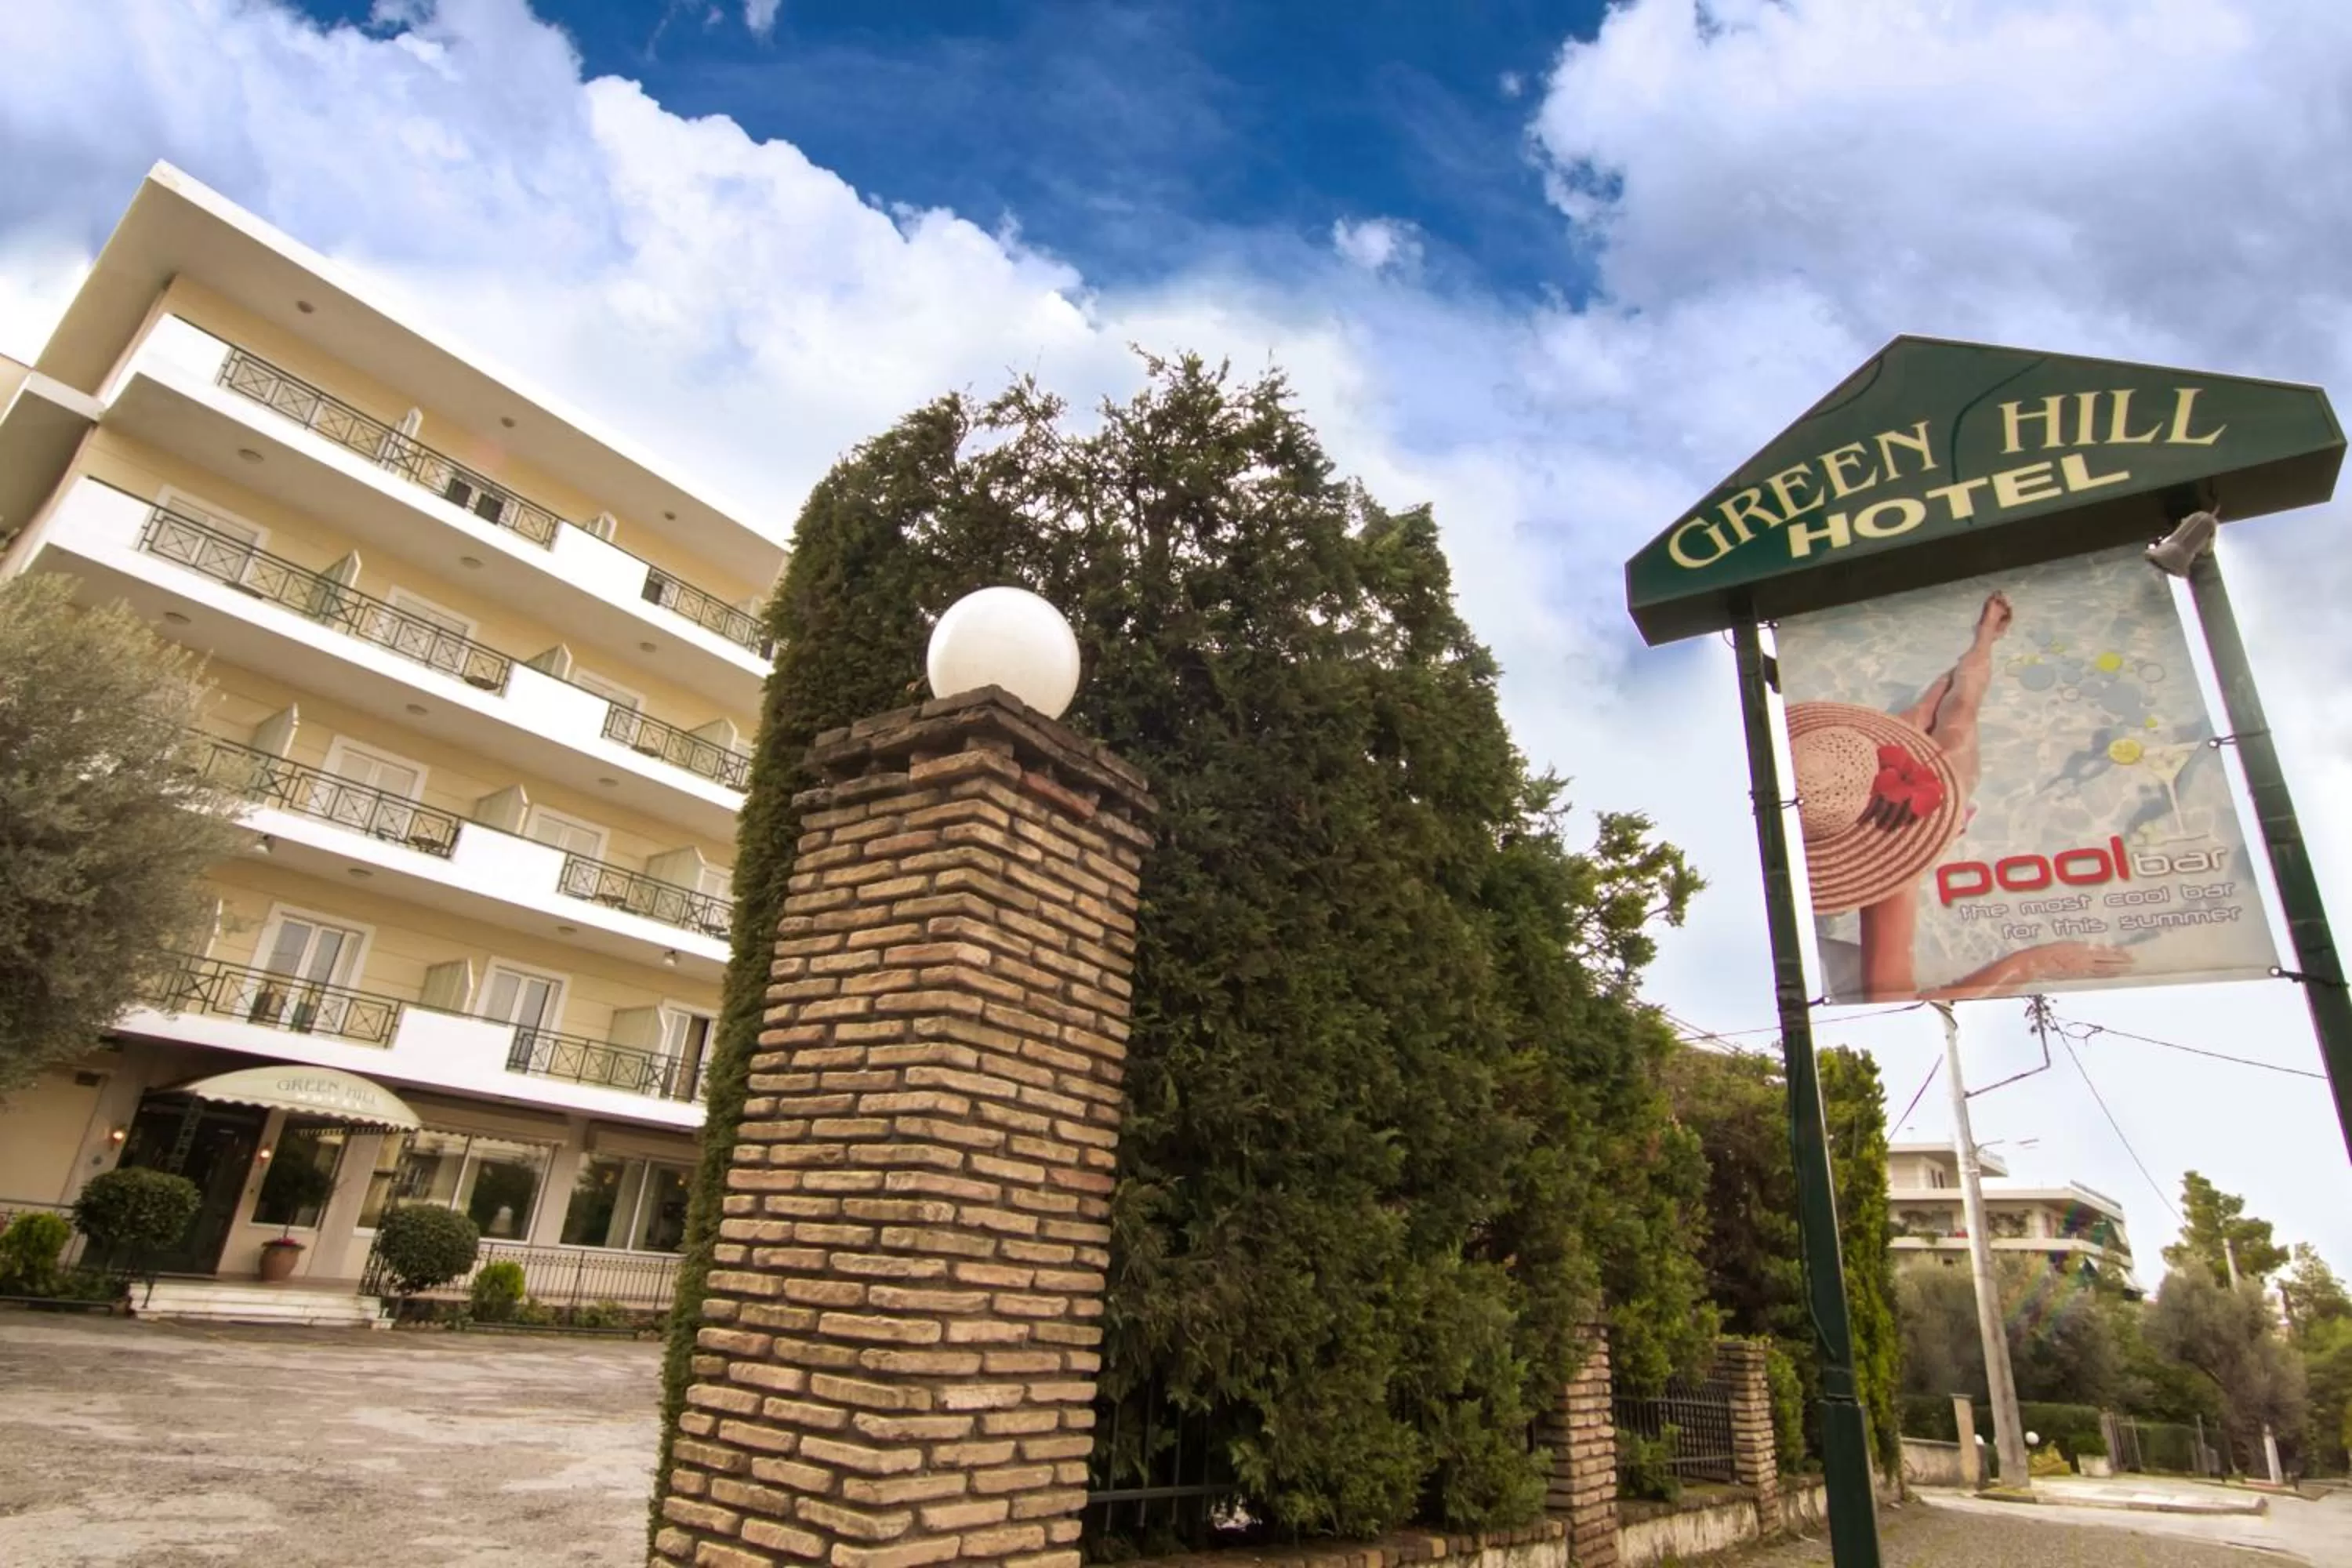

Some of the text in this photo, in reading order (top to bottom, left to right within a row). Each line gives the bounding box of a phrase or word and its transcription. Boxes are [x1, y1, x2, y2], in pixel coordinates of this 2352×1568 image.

[1668, 387, 2228, 570] GREEN HILL
[1788, 452, 2133, 559] HOTEL
[1959, 880, 2235, 921] the most cool bar
[2002, 904, 2243, 941] for this summer
[276, 1078, 339, 1092] GREEN
